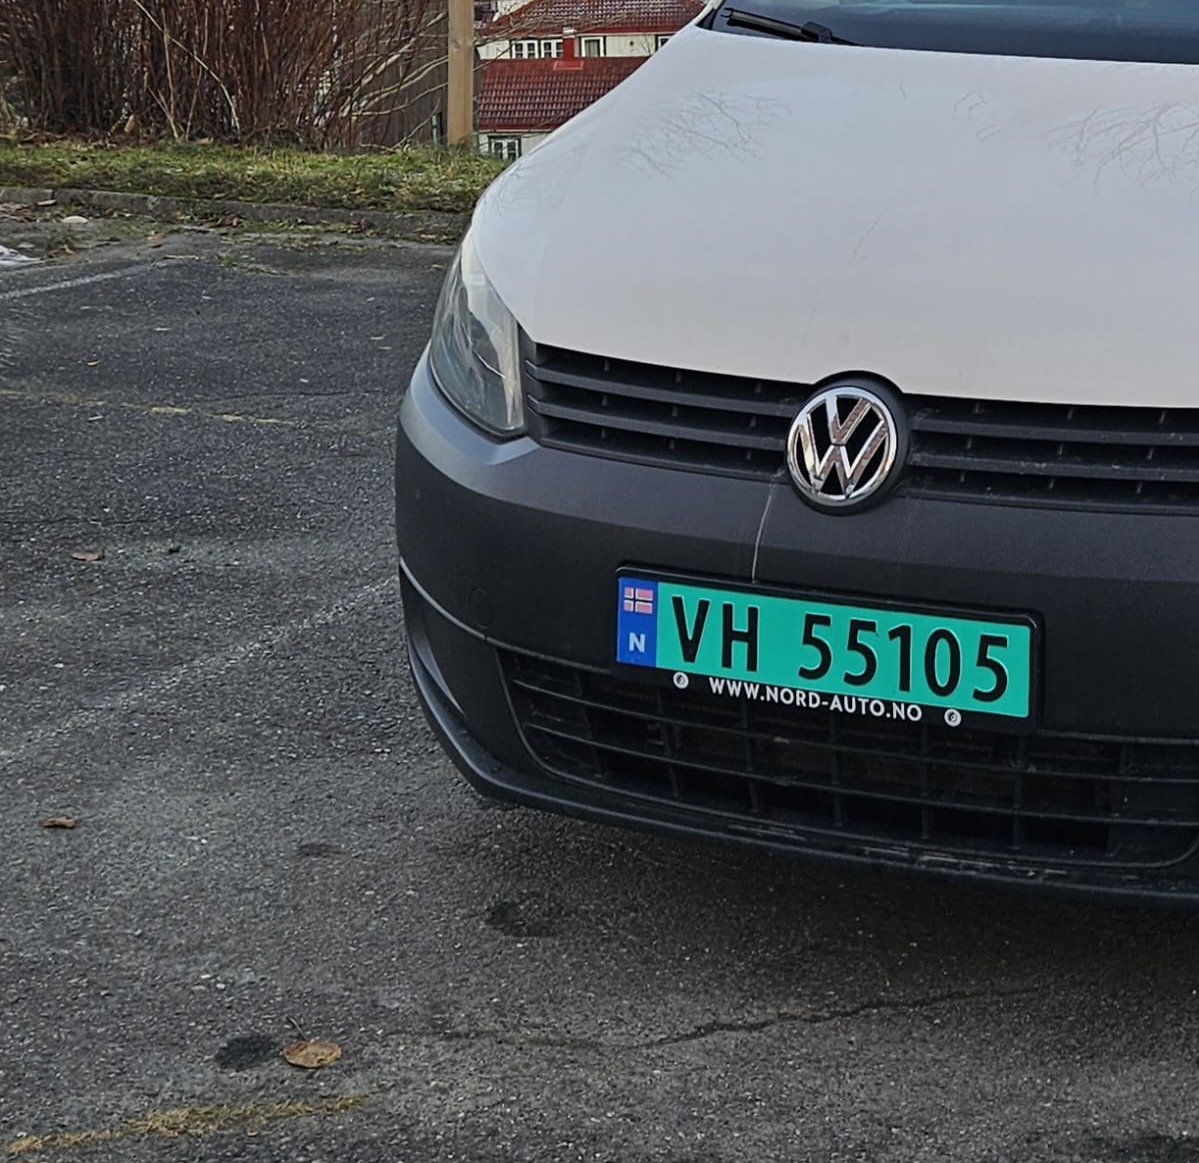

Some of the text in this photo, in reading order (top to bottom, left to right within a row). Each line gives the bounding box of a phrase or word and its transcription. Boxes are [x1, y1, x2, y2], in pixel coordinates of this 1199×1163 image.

[629, 632, 646, 653] N
[671, 595, 1009, 703] VH 55105
[708, 676, 923, 722] WWW.NORD-AUTO.NO
